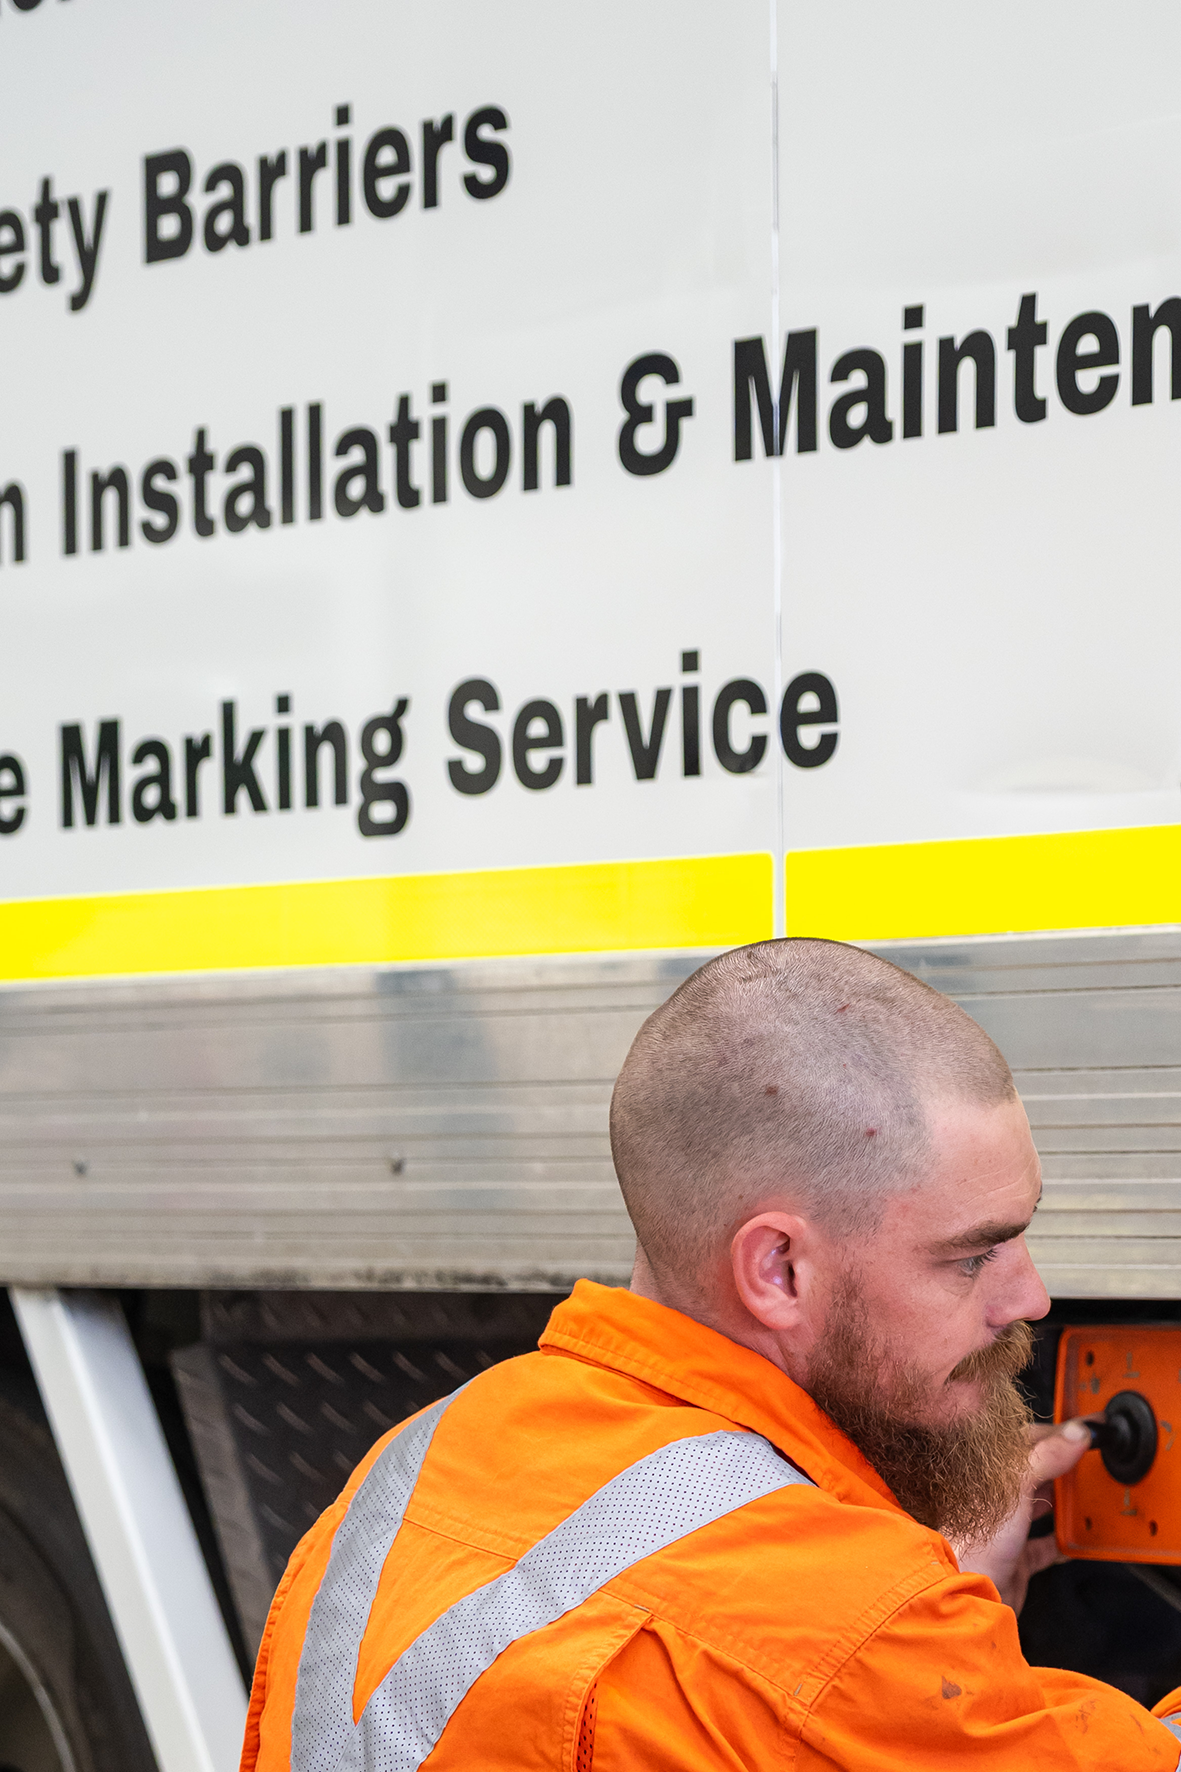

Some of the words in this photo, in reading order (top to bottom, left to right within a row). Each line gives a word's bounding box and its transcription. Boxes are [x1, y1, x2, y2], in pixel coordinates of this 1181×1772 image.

[143, 102, 512, 266] Barriers
[62, 381, 573, 557] Installation
[618, 351, 695, 478] &
[59, 693, 412, 839] Marking
[446, 649, 840, 797] Service
